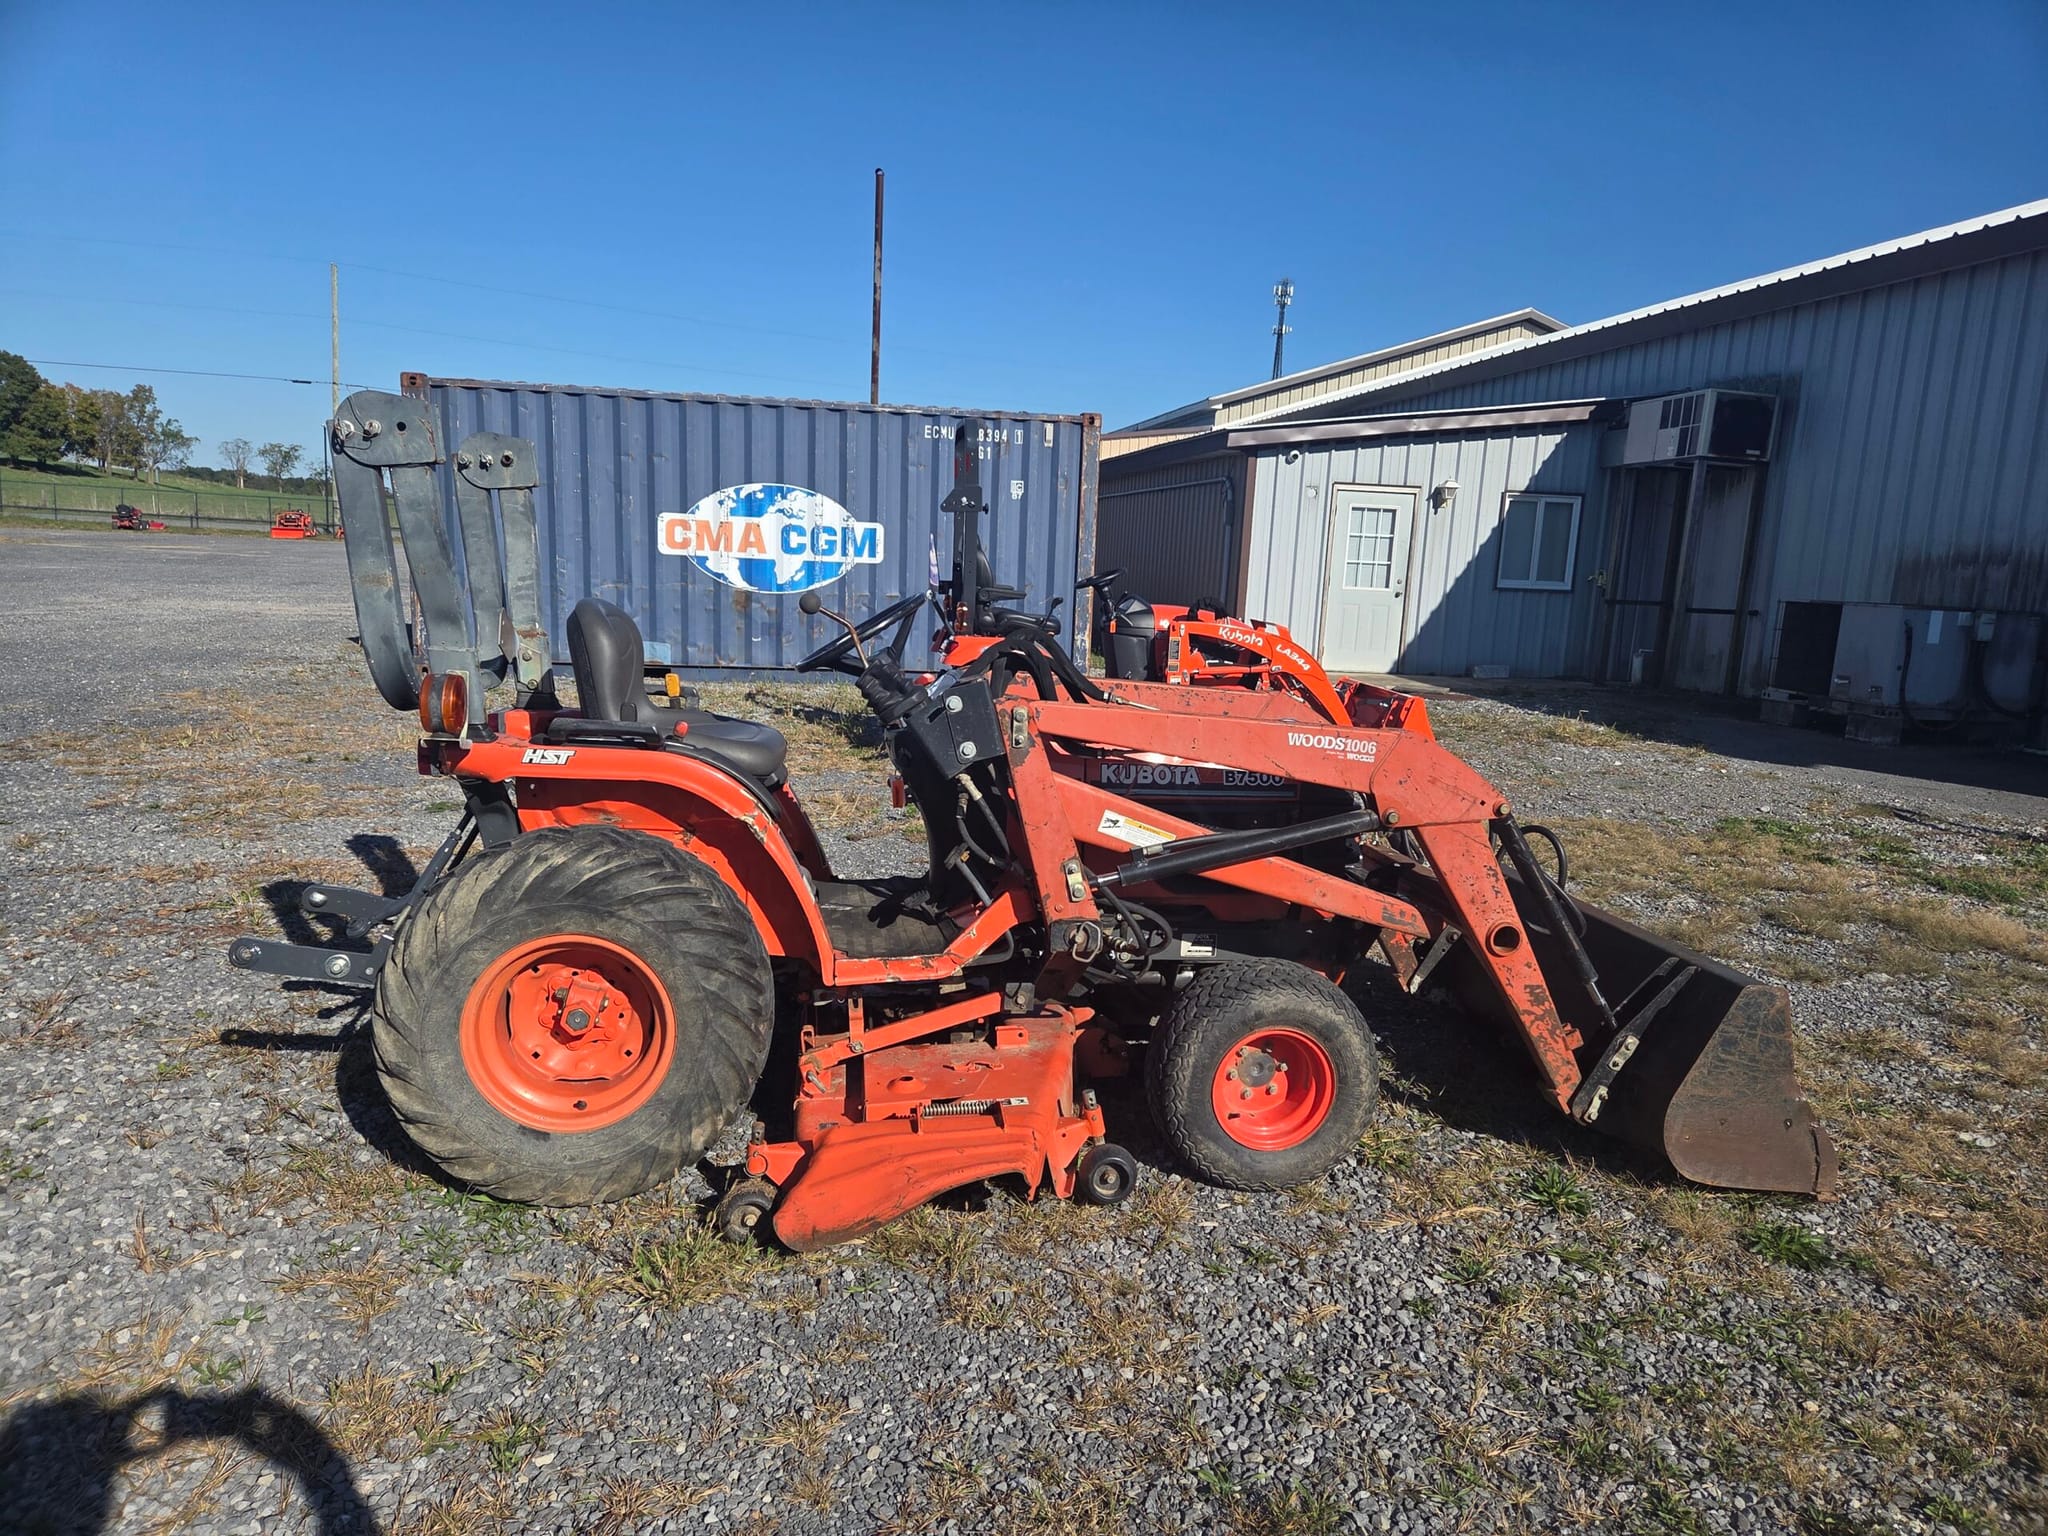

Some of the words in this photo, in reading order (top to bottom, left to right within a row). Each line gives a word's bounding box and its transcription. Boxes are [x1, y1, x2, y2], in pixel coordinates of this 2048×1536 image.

[924, 425, 954, 440] ECMU
[664, 518, 767, 554] CMA
[780, 524, 877, 558] CGM
[1219, 627, 1263, 646] Kubota
[1276, 644, 1311, 671] LA344
[522, 748, 576, 765] HST
[1101, 763, 1200, 785] KUBOTA
[1223, 769, 1285, 786] B7500
